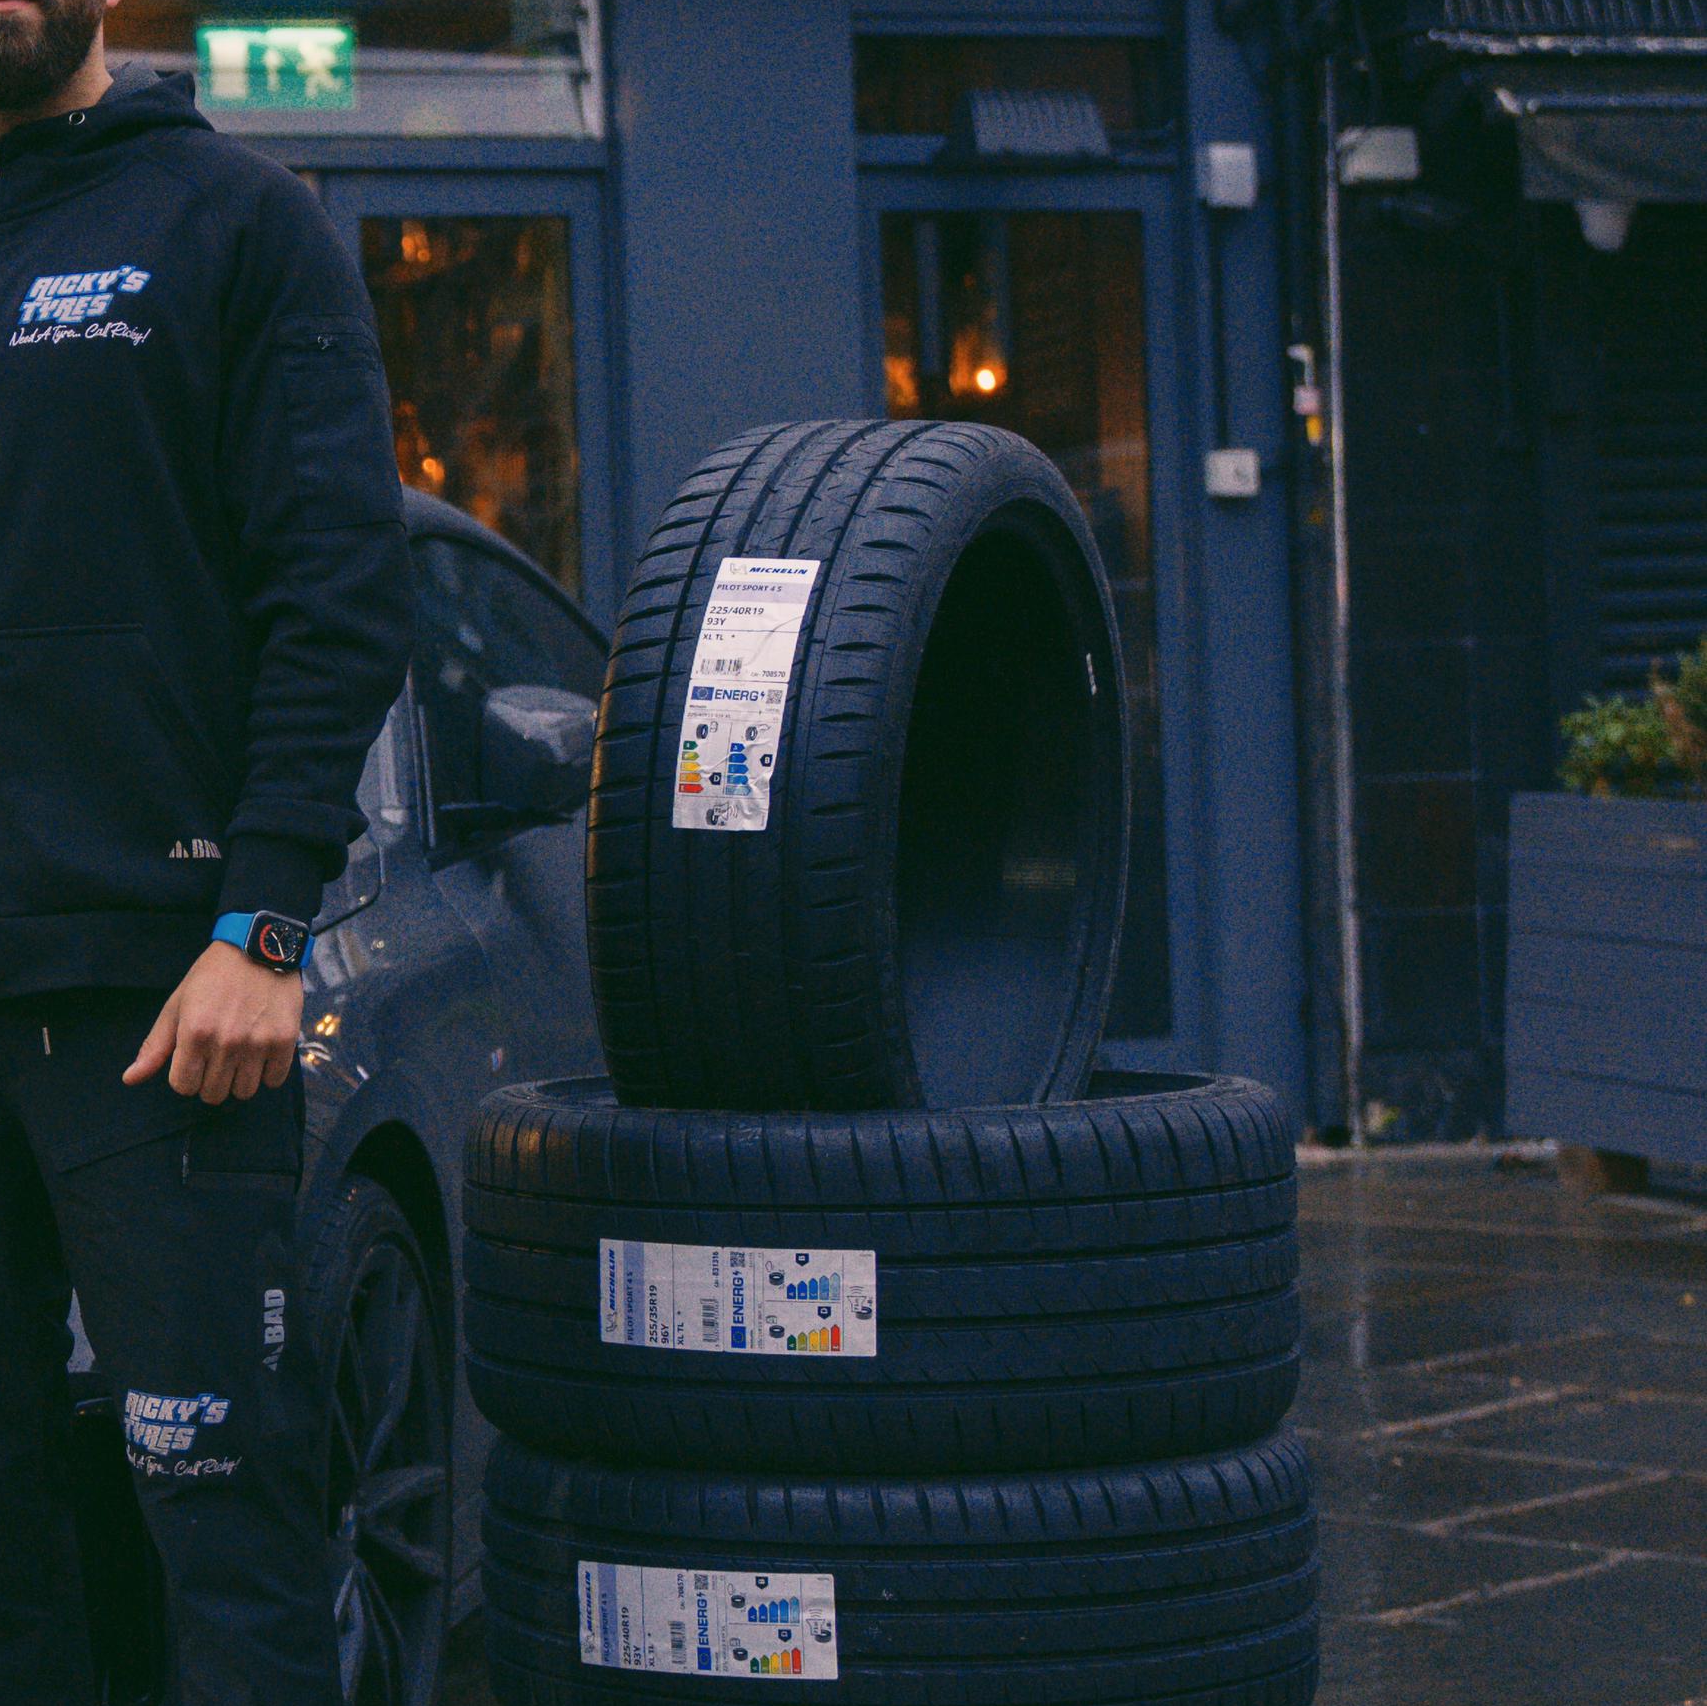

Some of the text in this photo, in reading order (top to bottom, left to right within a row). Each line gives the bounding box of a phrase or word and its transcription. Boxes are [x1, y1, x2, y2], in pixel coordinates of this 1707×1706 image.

[27, 265, 151, 298] RICKY'S
[18, 293, 113, 324] TYRES
[709, 606, 764, 614] 225/40R19
[715, 689, 758, 701] ENERG
[608, 1248, 616, 1311] MICHELIN
[264, 1289, 285, 1344] BAD
[649, 1284, 658, 1344] 255/35R19
[733, 1277, 744, 1325] ENERG
[661, 1323, 669, 1344] 96Y
[677, 1322, 684, 1345] XL TL
[125, 1391, 229, 1424] RICKY'S
[124, 1418, 196, 1456] TYRES
[621, 1606, 631, 1665] 225/40R19
[697, 1598, 709, 1646] ENERG
[633, 1645, 641, 1666] 93Y
